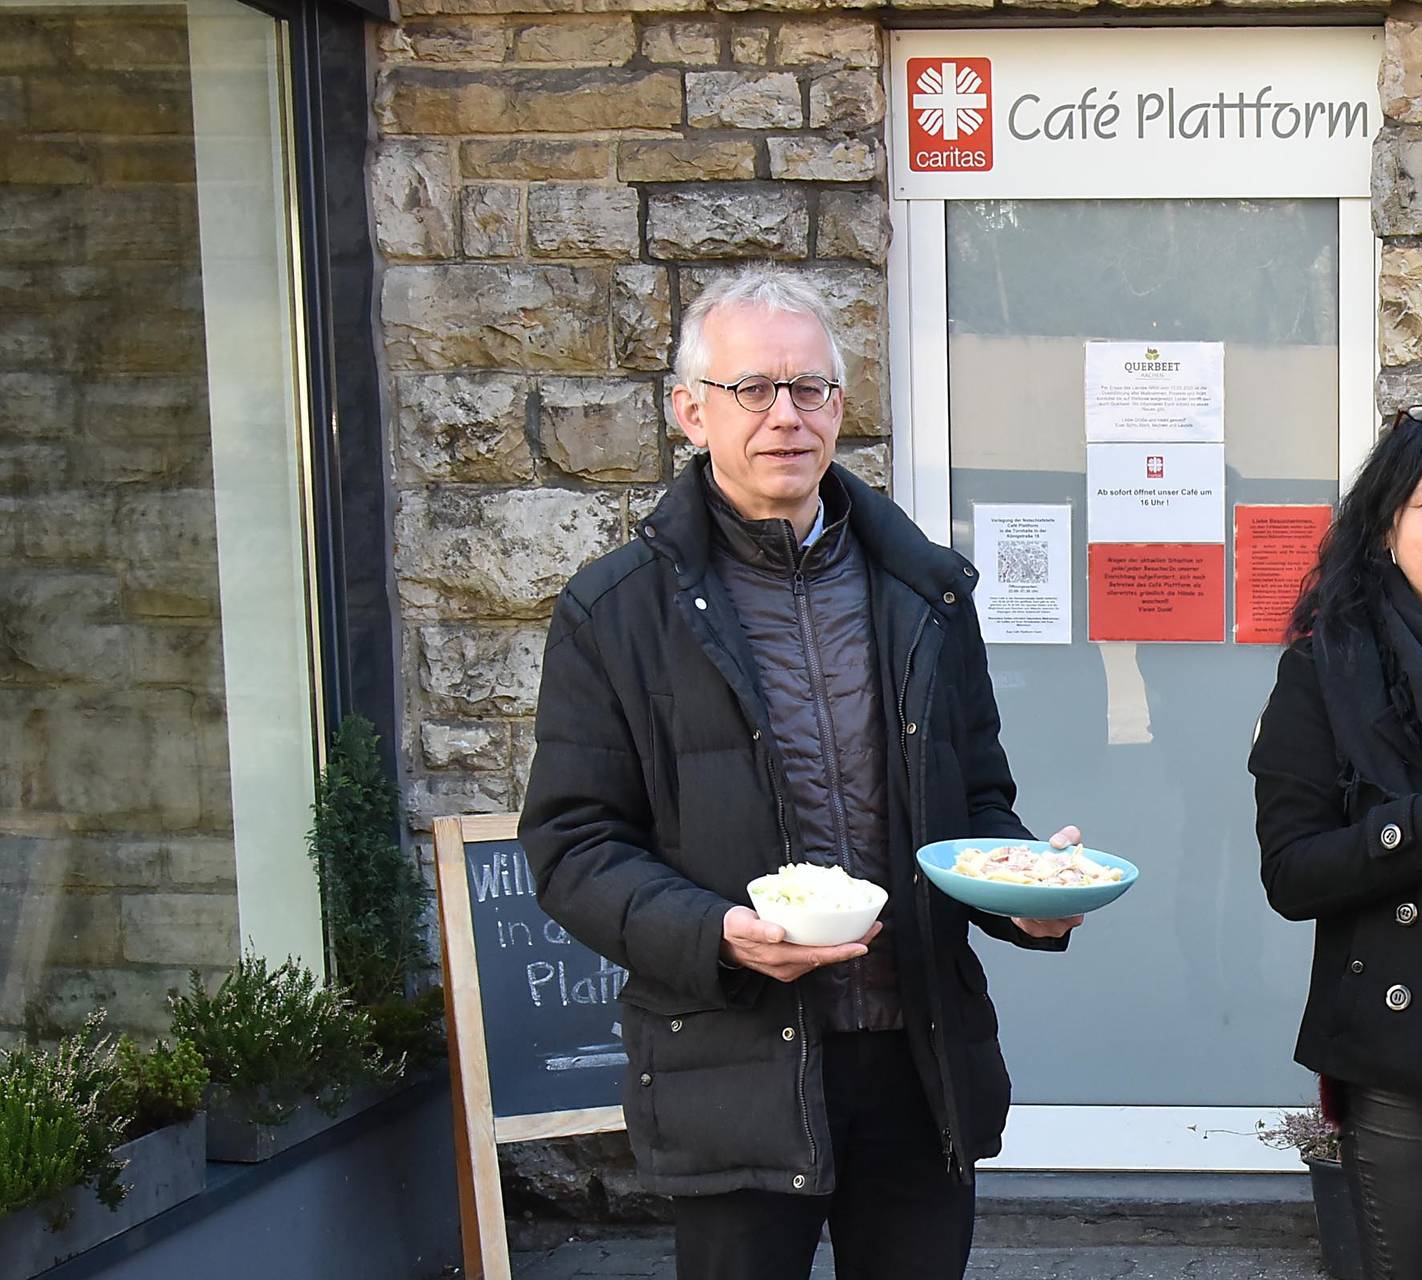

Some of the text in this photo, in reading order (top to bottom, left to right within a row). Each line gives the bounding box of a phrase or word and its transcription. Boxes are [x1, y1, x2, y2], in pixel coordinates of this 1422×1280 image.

[1008, 85, 1368, 141] Café Plattform
[916, 146, 986, 169] caritas
[1124, 362, 1180, 373] QUERBEET
[467, 850, 536, 902] Will
[495, 907, 533, 947] in
[526, 955, 630, 1006] Platt
